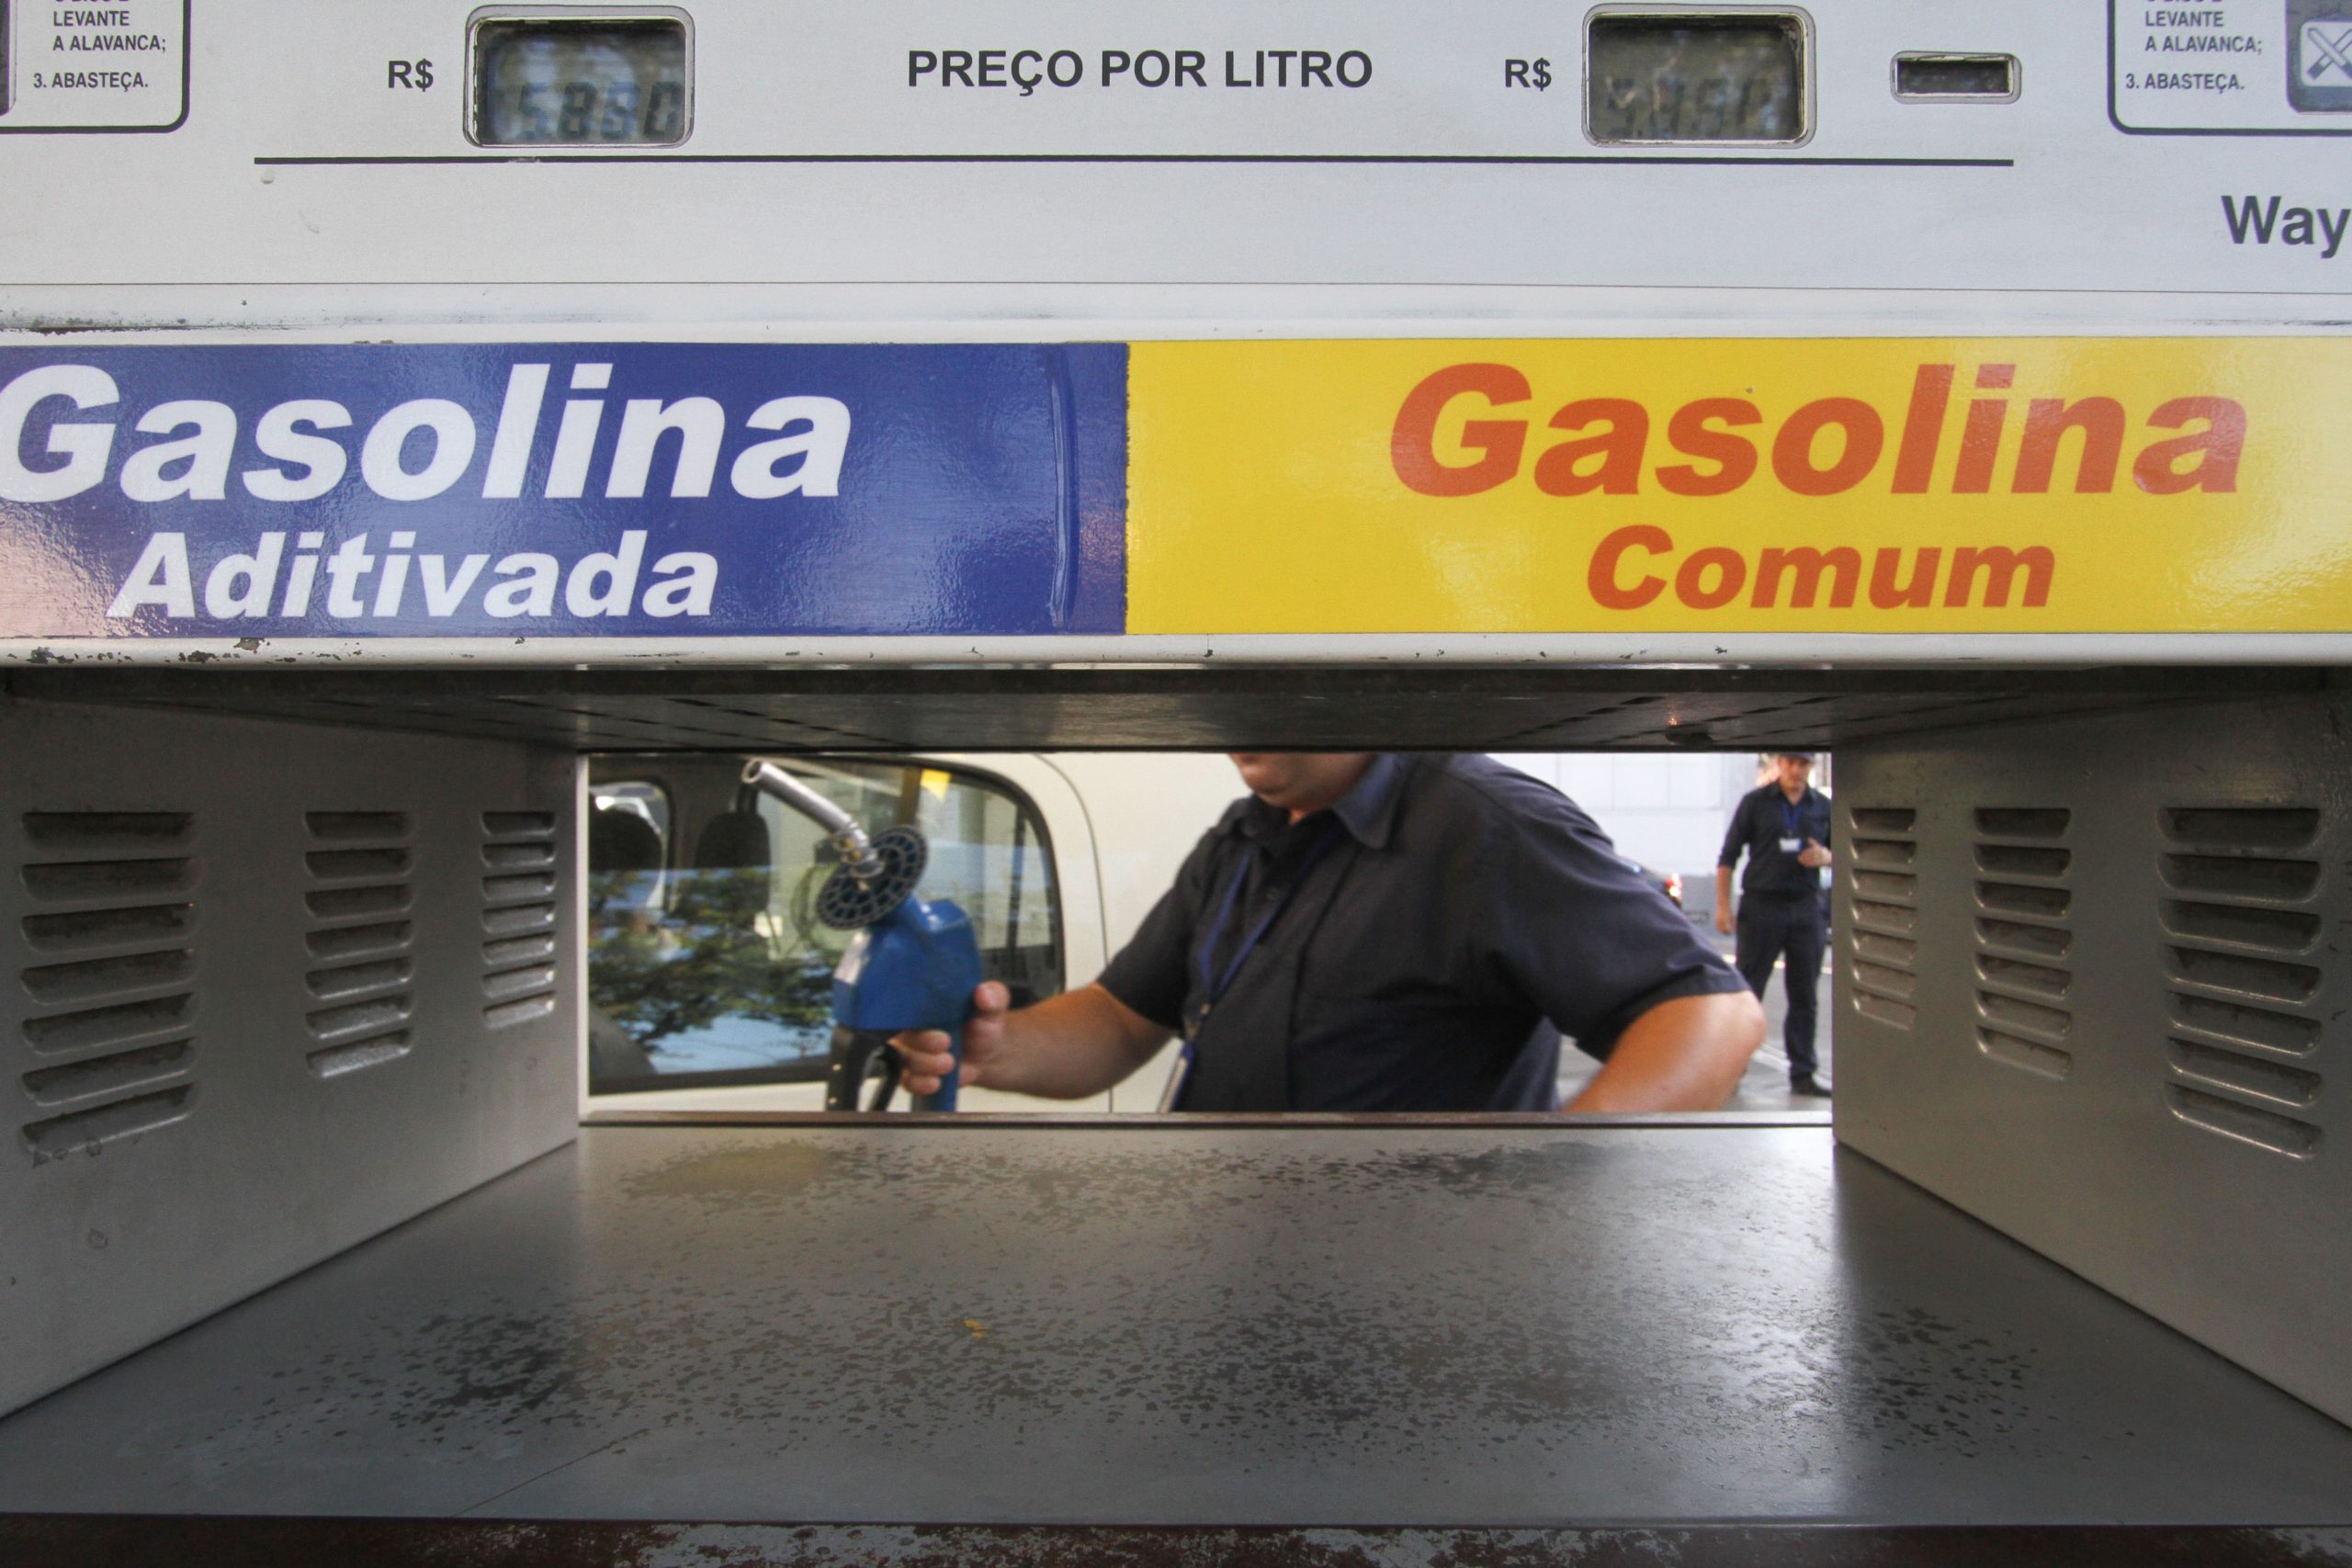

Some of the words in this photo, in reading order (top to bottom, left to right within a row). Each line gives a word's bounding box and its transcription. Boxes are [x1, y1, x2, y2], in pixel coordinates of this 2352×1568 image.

[53, 10, 130, 27] LEVANTE
[2145, 10, 2224, 28] LEVANTE
[52, 35, 64, 51] A
[69, 34, 166, 53] ALAVANCA;
[2144, 35, 2157, 52] A
[2162, 35, 2262, 55] ALAVANCA;
[33, 73, 47, 89] 3.
[51, 72, 149, 93] ABASTEÇA.
[388, 58, 434, 93] R$
[908, 50, 1083, 96] PREÇO
[1101, 50, 1207, 88] POR
[1225, 50, 1373, 88] LITRO
[1504, 58, 1553, 92] R$
[2125, 73, 2140, 89] 3.
[2144, 73, 2245, 94] ABASTEÇA.
[2221, 195, 2352, 259] Way
[0, 363, 852, 502] Gasolina
[1390, 362, 2248, 498] Gasolina
[106, 529, 719, 619] Aditivada
[1587, 525, 2055, 611] Comum
